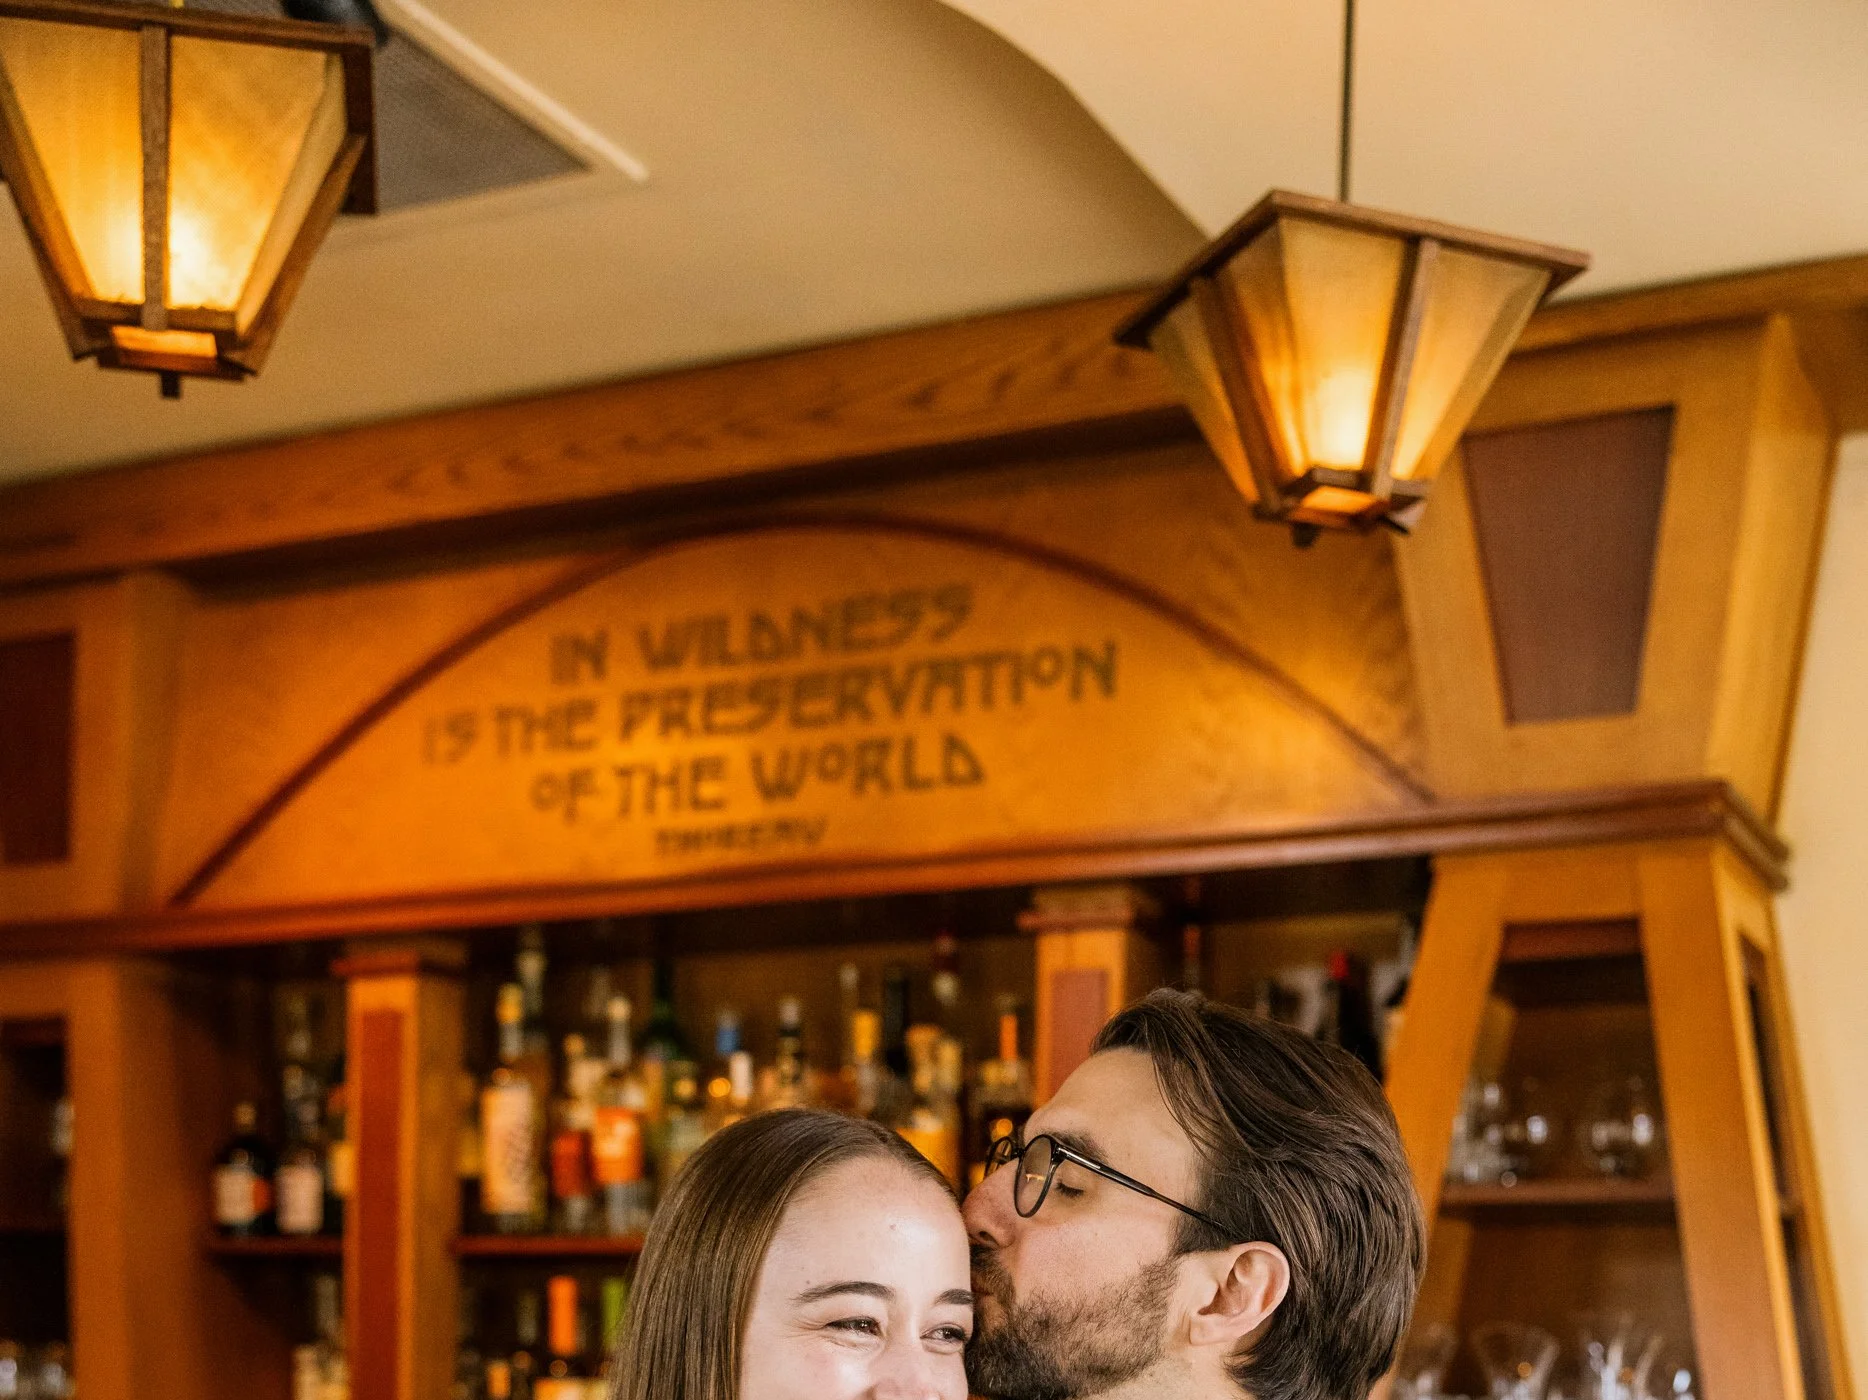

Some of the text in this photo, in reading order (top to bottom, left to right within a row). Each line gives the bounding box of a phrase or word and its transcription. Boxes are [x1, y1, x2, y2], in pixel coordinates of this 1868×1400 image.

[552, 584, 974, 686] IN WILDNESS
[422, 639, 1117, 766] IS THE PRESERVATION
[530, 733, 986, 826] OF THE WORLD
